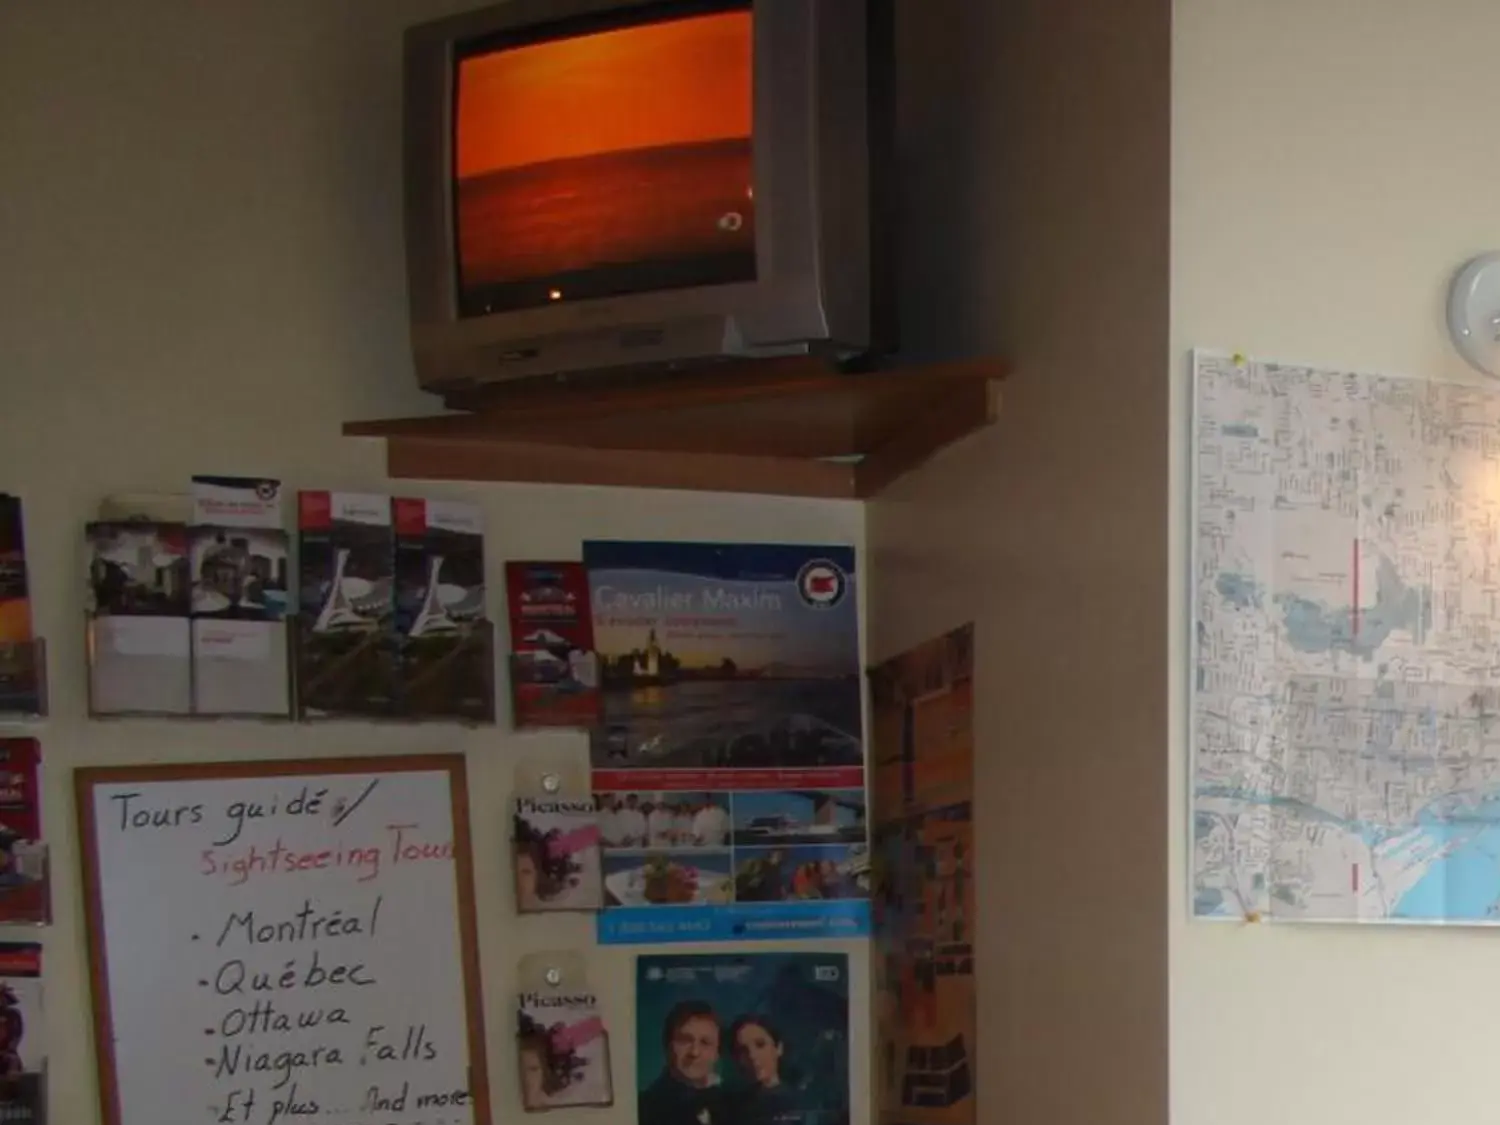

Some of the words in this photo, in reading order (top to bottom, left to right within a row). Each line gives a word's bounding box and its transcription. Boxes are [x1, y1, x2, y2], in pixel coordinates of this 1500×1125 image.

[595, 584, 692, 610] Cavalier
[701, 585, 782, 611] Maxim
[109, 793, 204, 830] Tours
[201, 838, 380, 887] Sightseeing
[216, 895, 382, 948] Montréal
[215, 951, 377, 996] Québec
[221, 1000, 350, 1038] Ottawa
[518, 992, 597, 1009] Picasso
[214, 1044, 344, 1090] Niagara
[359, 1023, 438, 1066] Falls
[217, 1088, 256, 1123] Et
[416, 1090, 471, 1110] more
